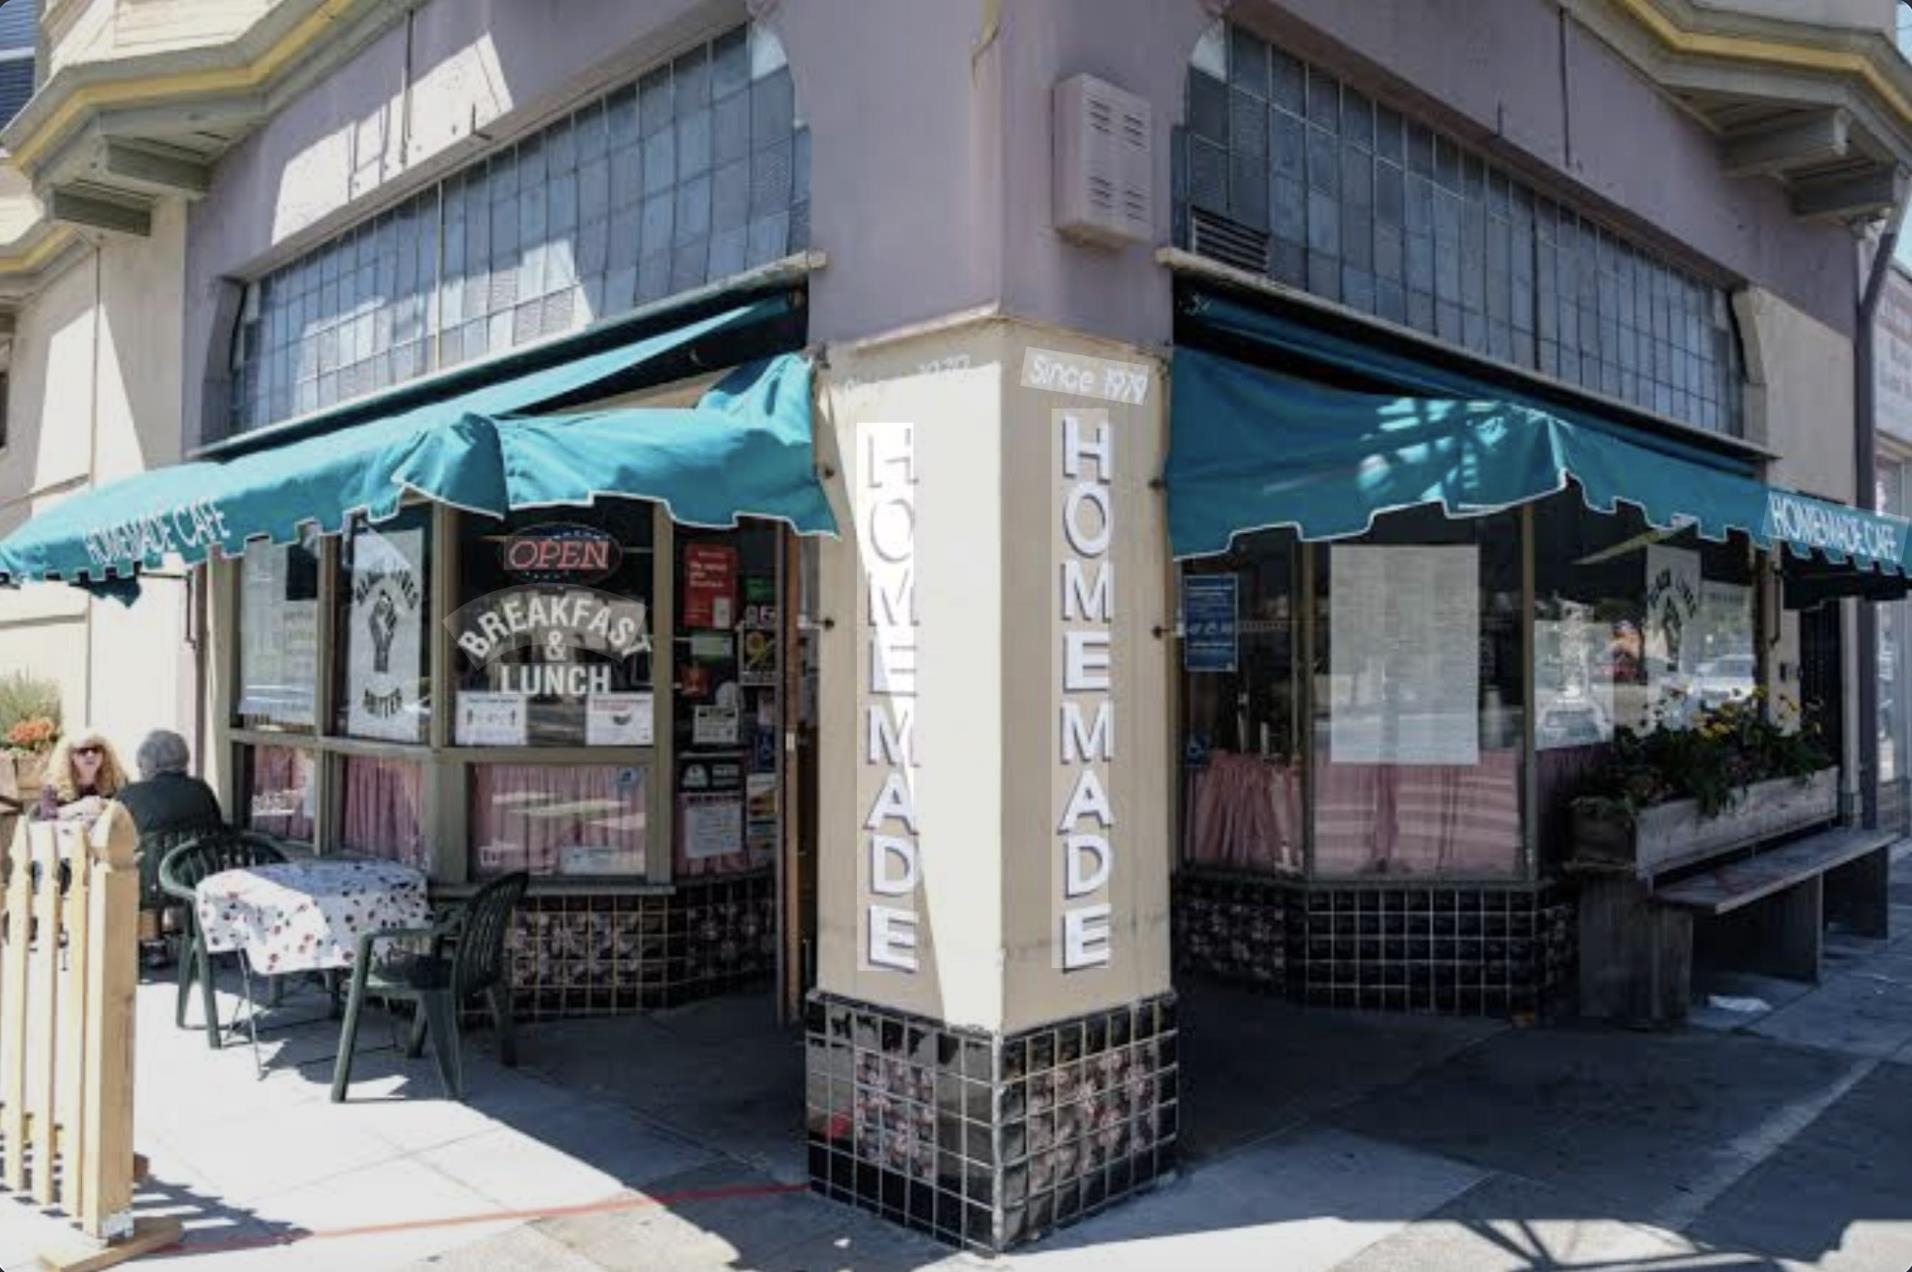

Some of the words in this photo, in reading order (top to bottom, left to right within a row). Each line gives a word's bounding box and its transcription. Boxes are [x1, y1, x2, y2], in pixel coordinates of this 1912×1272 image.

[1031, 354, 1094, 394] Since
[173, 498, 231, 548] CAFE
[1771, 496, 1864, 555] HOMEMADE
[1864, 521, 1897, 561] CAFE
[508, 540, 610, 568] OPEN
[457, 596, 652, 659] BREAKFAST
[545, 630, 567, 661] &
[501, 665, 611, 696] LUNCH
[864, 427, 920, 974] HOMEMADE
[1058, 414, 1114, 974] HOMEMADE
